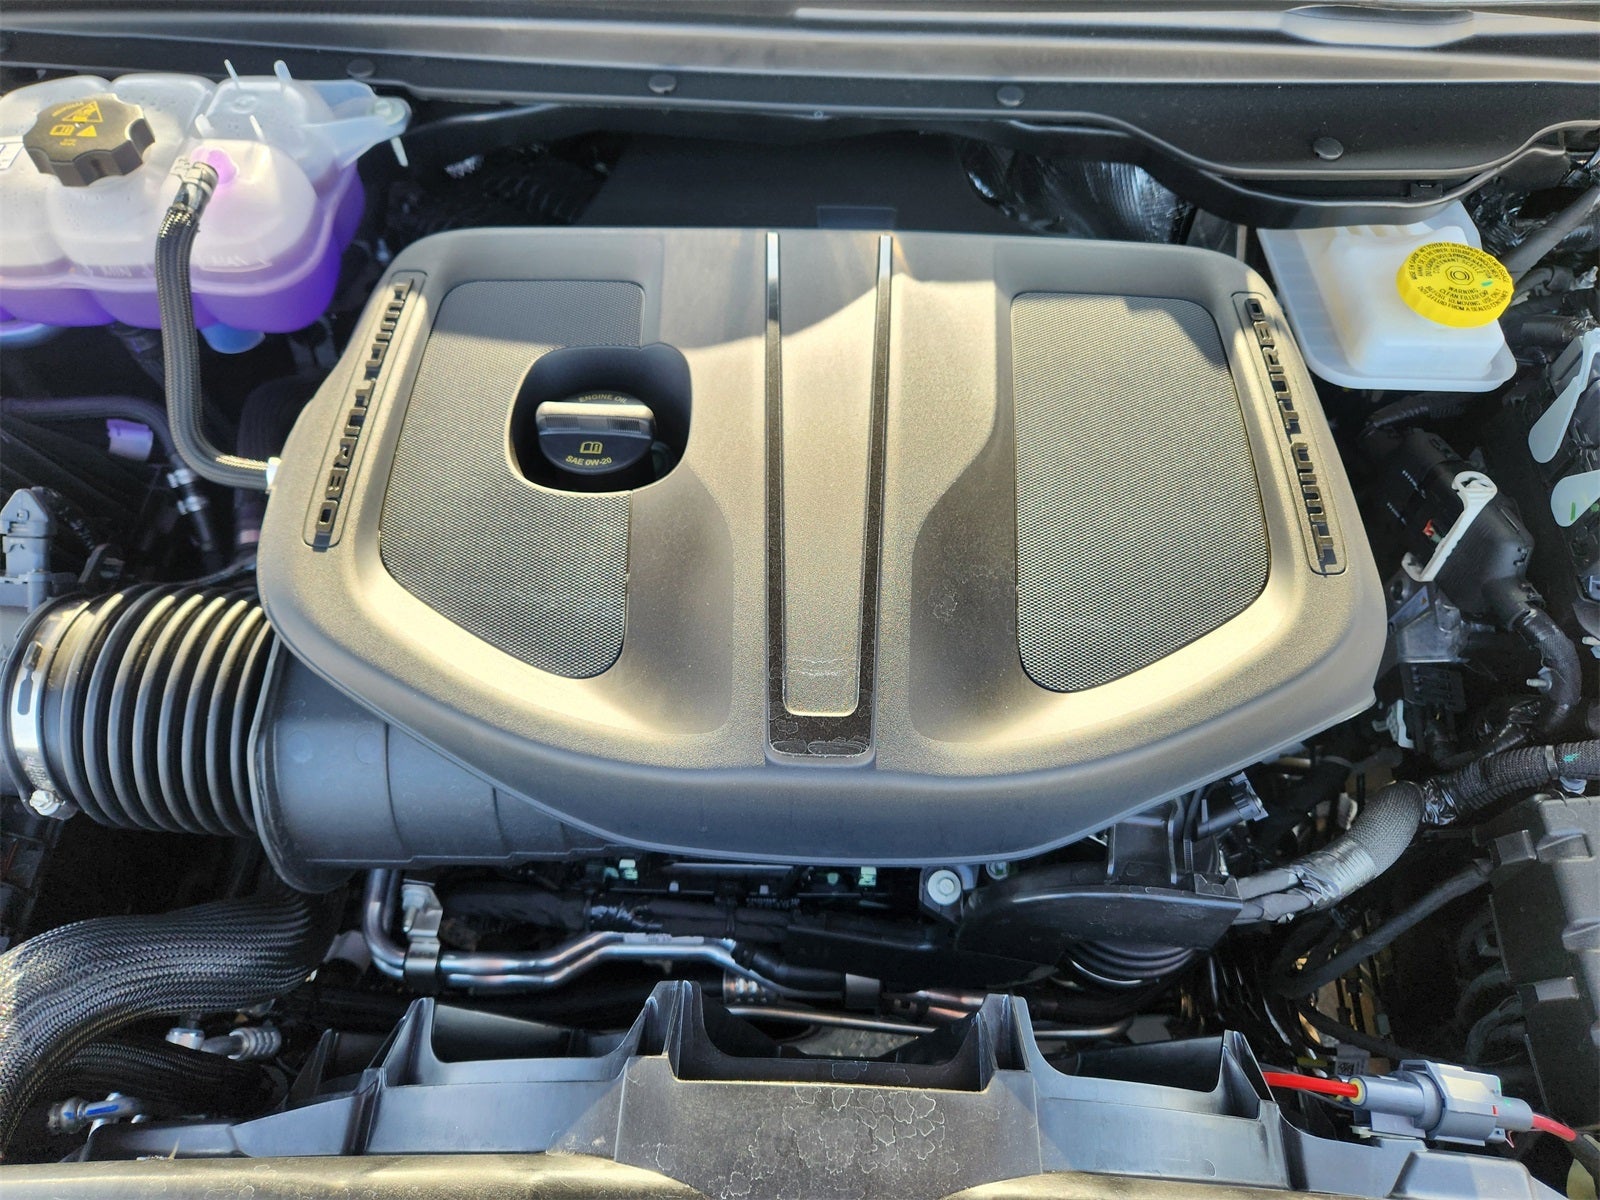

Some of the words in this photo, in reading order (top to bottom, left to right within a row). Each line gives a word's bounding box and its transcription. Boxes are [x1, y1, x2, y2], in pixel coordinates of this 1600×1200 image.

[578, 393, 613, 403] ENGINE
[614, 395, 628, 405] OIL
[1244, 297, 1300, 431] TURBO
[315, 378, 377, 534] TURBO
[565, 455, 584, 466] SAE
[585, 457, 613, 466] 0W-20
[1289, 441, 1335, 562] TWIN
